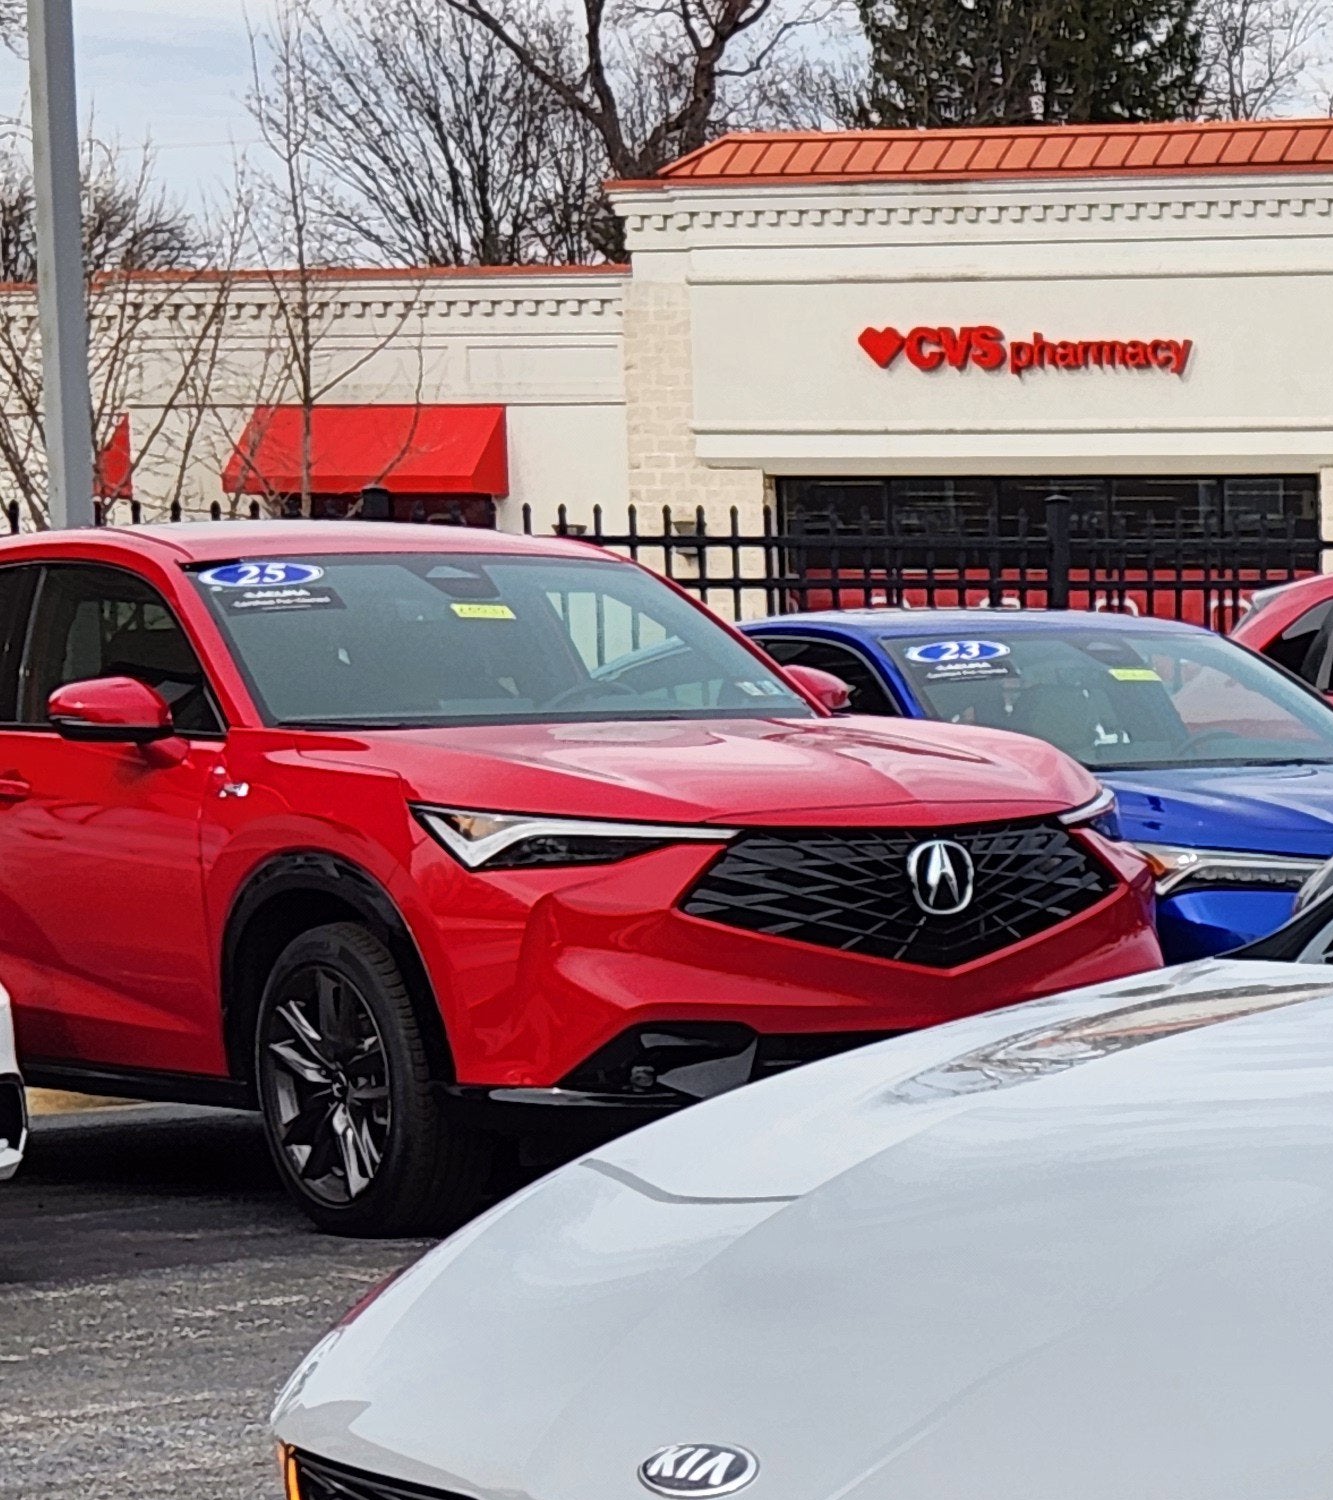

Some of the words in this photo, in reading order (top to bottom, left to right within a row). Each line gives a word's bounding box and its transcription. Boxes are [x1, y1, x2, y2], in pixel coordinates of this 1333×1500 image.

[906, 326, 1007, 371] CVS
[1010, 332, 1193, 375] pharmacy
[236, 563, 287, 585] 25
[939, 641, 981, 660] 23
[646, 1447, 736, 1485] KIA
